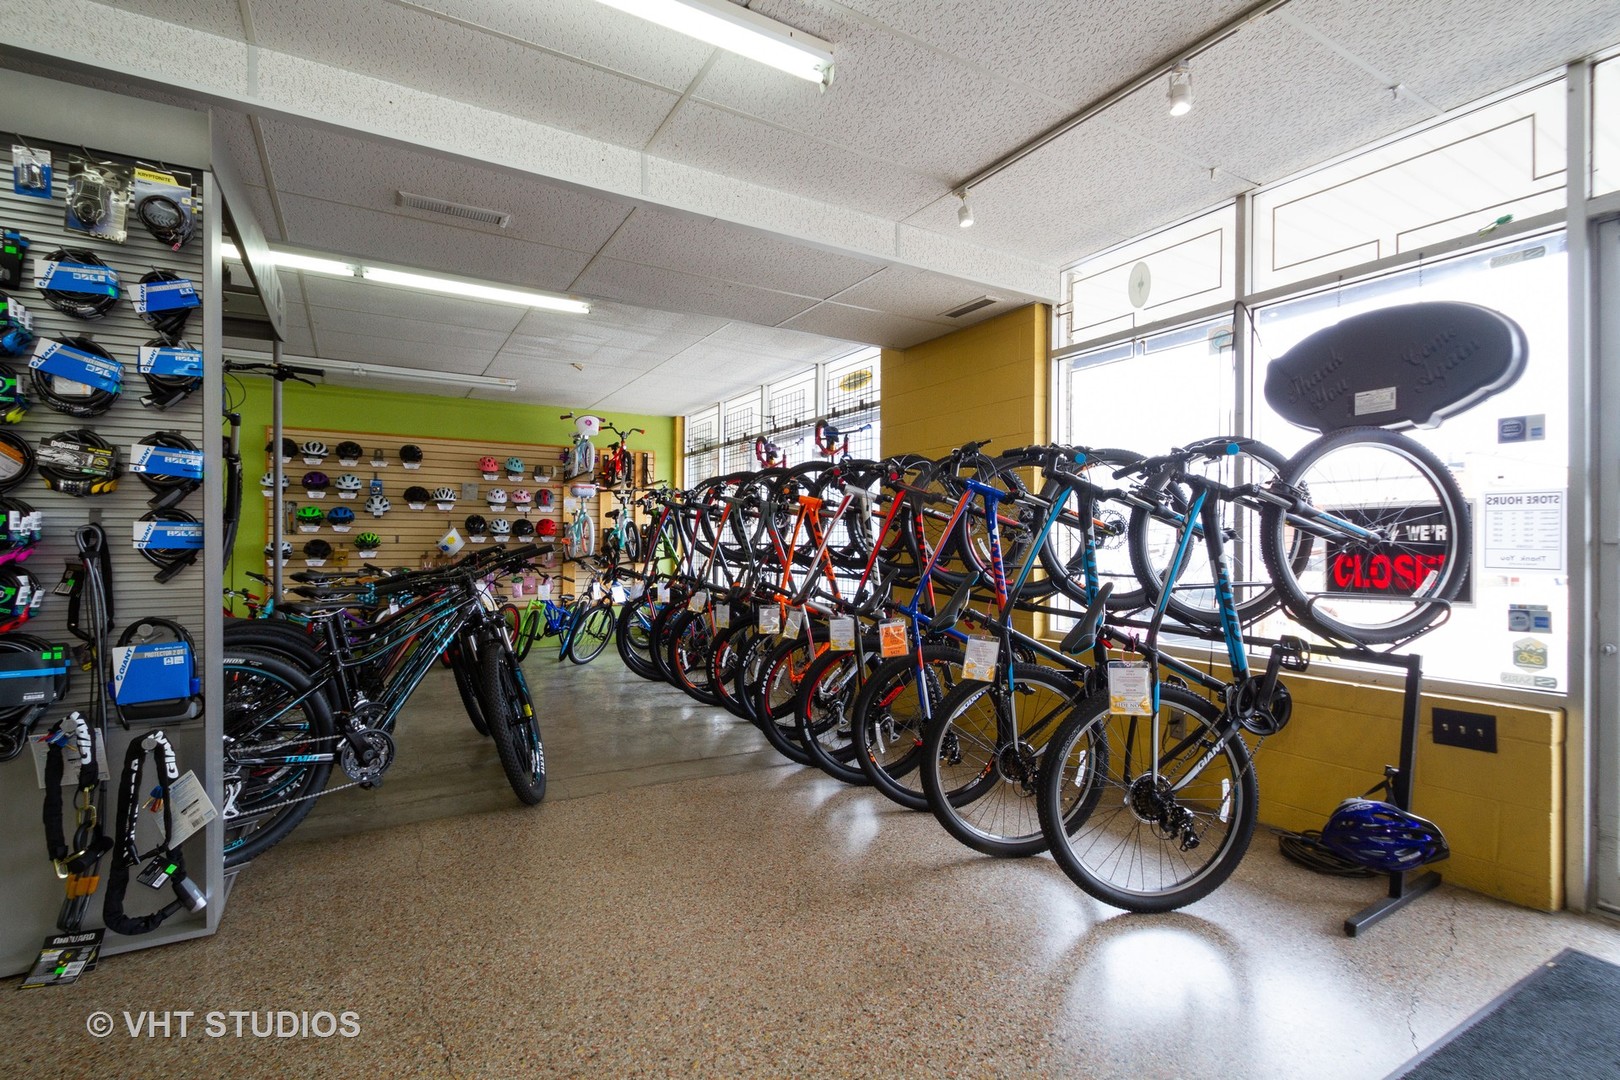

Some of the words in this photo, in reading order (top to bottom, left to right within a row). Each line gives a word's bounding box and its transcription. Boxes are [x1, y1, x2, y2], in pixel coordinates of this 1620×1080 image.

[138, 172, 171, 182] KRYPTONITE
[37, 343, 58, 362] GIANT
[1405, 524, 1447, 541] WE'R
[1334, 554, 1446, 590] CLOSE
[118, 648, 133, 674] GIANT
[743, 638, 760, 667] MAXXIS
[761, 660, 777, 696] MAXXIS
[70, 711, 92, 765] GIAN
[155, 730, 178, 778] GIAN
[1059, 725, 1081, 761] GIANT
[1197, 738, 1226, 770] GIANT
